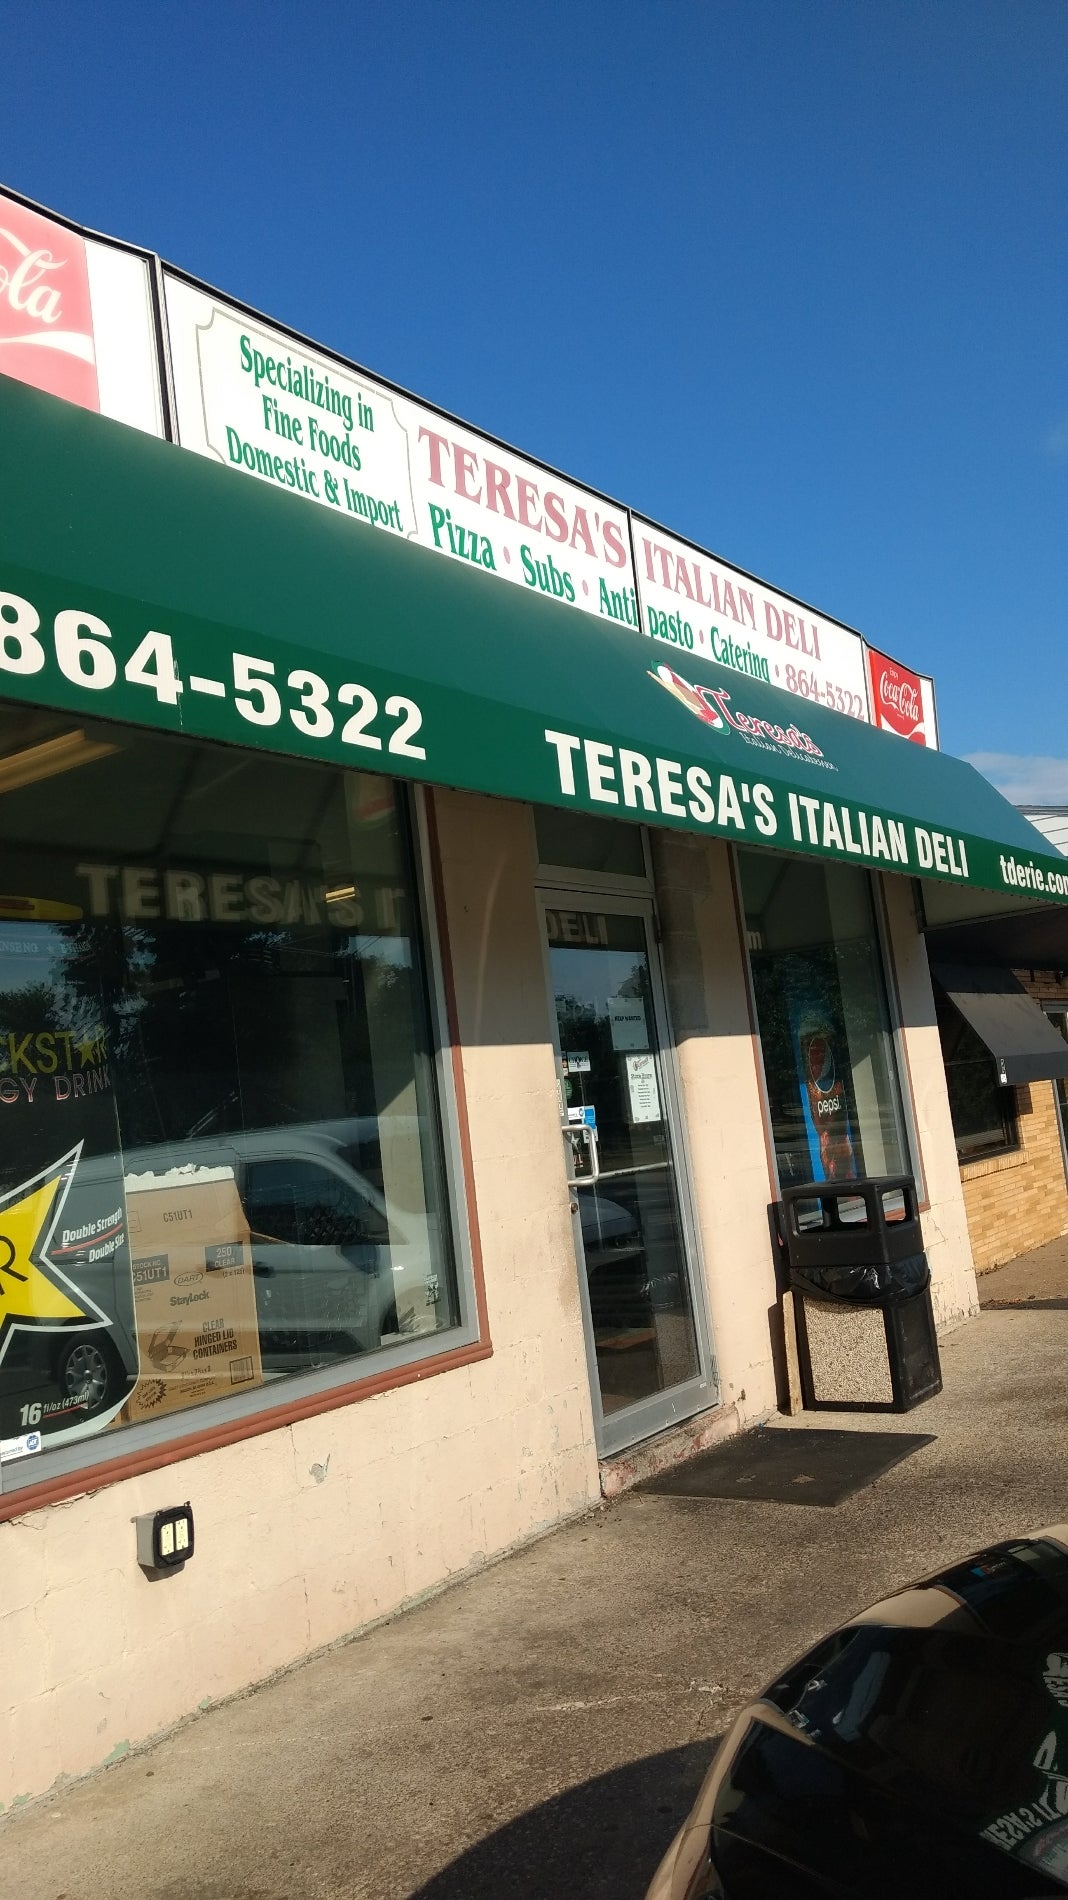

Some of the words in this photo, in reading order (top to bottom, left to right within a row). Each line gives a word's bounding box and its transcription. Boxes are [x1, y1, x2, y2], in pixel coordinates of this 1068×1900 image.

[240, 335, 353, 431] Specializing
[358, 392, 375, 433] in
[262, 394, 304, 446] Fine
[308, 417, 362, 471] Foods
[225, 426, 320, 498] Domestic
[324, 470, 339, 506] &
[343, 479, 404, 532] Import
[418, 425, 627, 569] TERESA'S
[642, 537, 757, 631] ITALIAN
[763, 600, 822, 661] DELI
[428, 502, 497, 571] Pizza
[520, 544, 576, 603] Subs
[599, 576, 639, 627] Anti
[647, 605, 694, 650] pasto
[710, 626, 771, 684] Catering
[785, 663, 865, 721] 864-5322
[0, 591, 427, 760] 864-5322
[545, 729, 777, 835] TERESA'S
[788, 793, 909, 863] ITALIAN
[915, 827, 969, 877] DELI
[53, 1063, 112, 1101] DRINK
[817, 1095, 841, 1117] pepsi
[62, 1223, 96, 1243] Double
[97, 1206, 123, 1233] Strength
[163, 1208, 193, 1223] C51UT1
[88, 1241, 115, 1263] Double
[215, 1258, 235, 1268] CLEAR
[216, 1246, 232, 1259] 250
[169, 1290, 210, 1307] StayLock
[202, 1318, 225, 1332] CLEAR
[193, 1340, 238, 1360] CONTAINERS
[194, 1331, 221, 1348] HINGED
[222, 1328, 235, 1340] LID
[20, 1402, 42, 1426] 16
